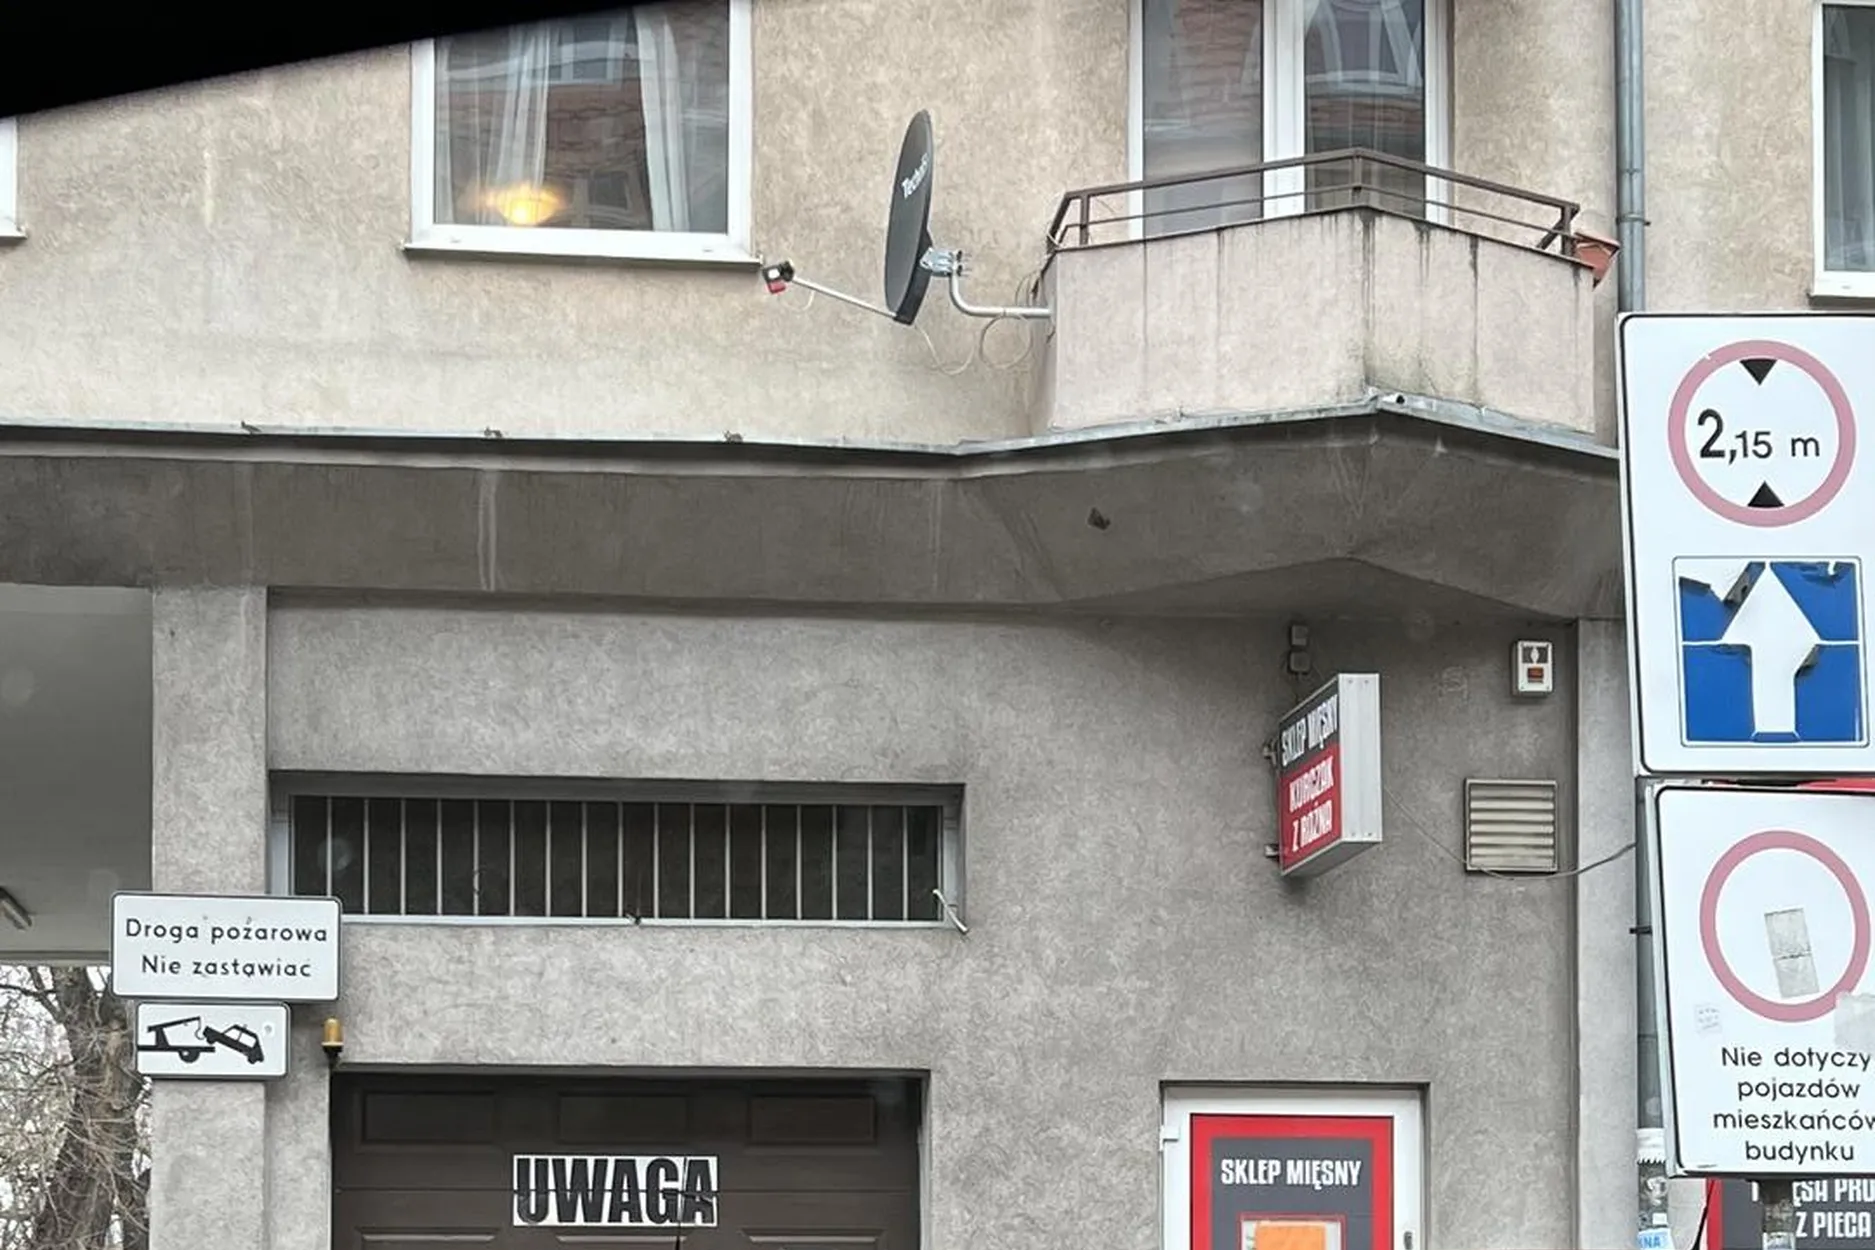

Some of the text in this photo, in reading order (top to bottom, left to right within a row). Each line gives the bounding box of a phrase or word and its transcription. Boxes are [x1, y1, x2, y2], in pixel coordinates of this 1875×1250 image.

[1697, 409, 1820, 464] 2,15 m
[126, 918, 199, 943] Droga
[141, 955, 182, 975] Nie
[1721, 1046, 1871, 1072] Nie dotyczy
[1737, 1077, 1860, 1102] pojazdów
[1745, 1140, 1854, 1165] budynku
[1221, 1159, 1362, 1190] SKLEP MIĘSNY
[516, 1157, 715, 1224] UWAGA
[1792, 1180, 1828, 1207] ĘSA
[1795, 1211, 1872, 1238] Z PIECA
